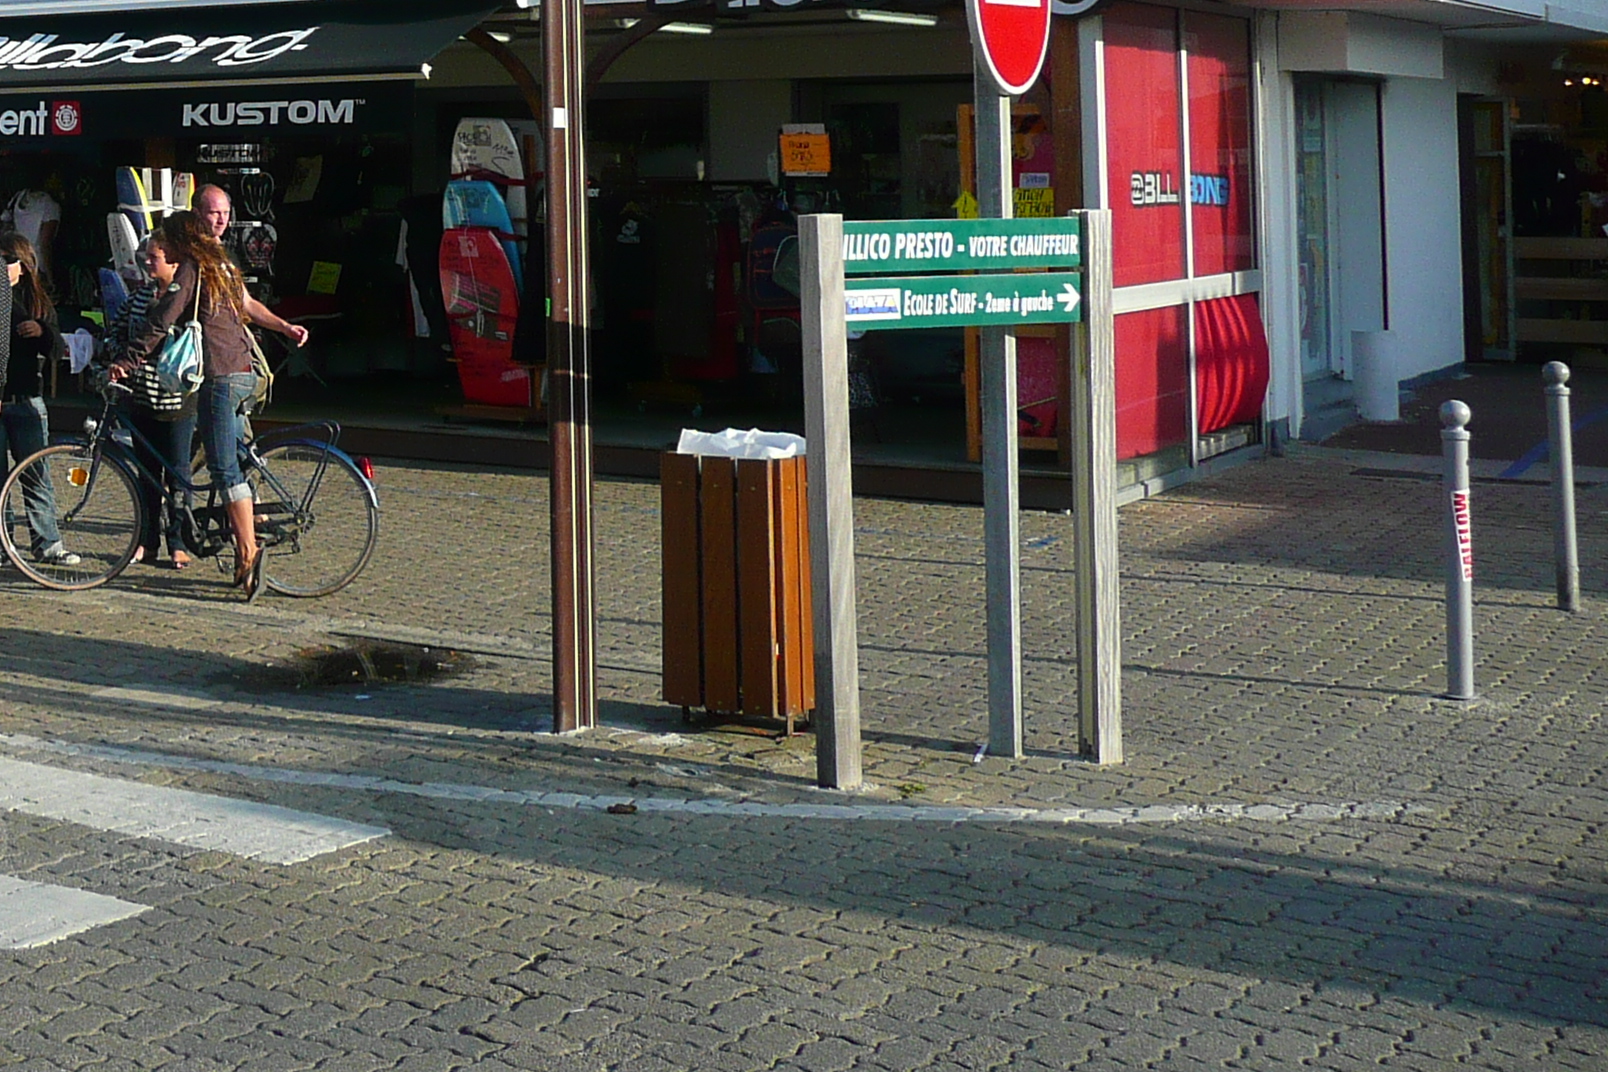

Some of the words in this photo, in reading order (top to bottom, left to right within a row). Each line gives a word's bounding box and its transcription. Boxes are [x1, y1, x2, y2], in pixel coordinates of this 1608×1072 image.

[843, 233, 890, 260] ILLICO
[895, 232, 953, 259] PRESTO
[969, 236, 1008, 257] VOTRE
[1010, 234, 1079, 256] CHAUFFEUR
[1013, 291, 1020, 312] à
[1021, 289, 1054, 317] gauche
